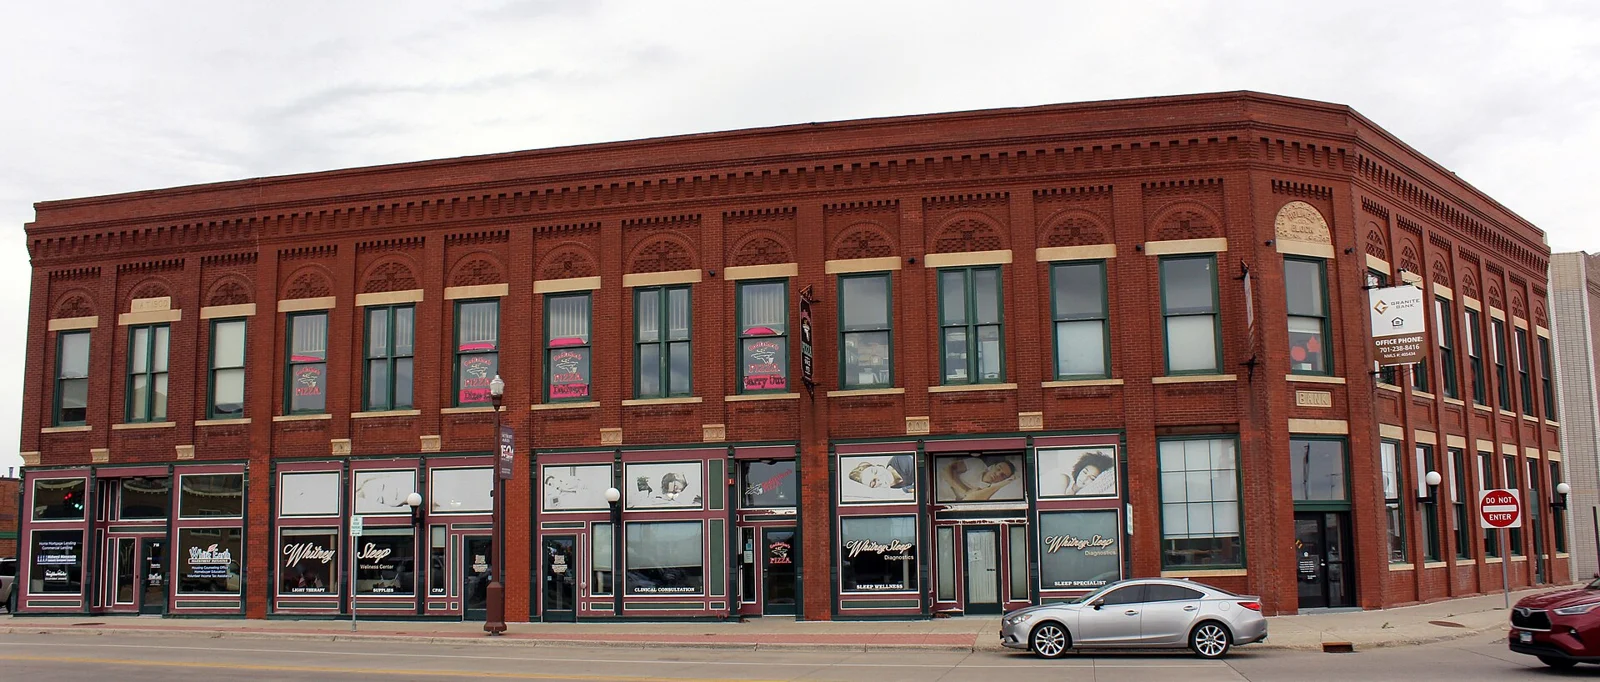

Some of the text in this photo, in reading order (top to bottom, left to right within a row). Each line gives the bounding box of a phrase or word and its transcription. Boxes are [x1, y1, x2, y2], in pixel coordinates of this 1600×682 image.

[1291, 223, 1314, 234] BLOCK
[1375, 336, 1423, 346] OFFICE PHONE:
[1380, 344, 1420, 353] 701-238-8416
[748, 363, 778, 373] PIZZA
[464, 378, 490, 387] PIZZA
[554, 373, 582, 382] PIZZA
[770, 376, 785, 384] Out
[296, 386, 321, 396] PIZZA
[1299, 392, 1330, 405] BANK
[1045, 534, 1114, 553] Whitney Sleep
[189, 546, 230, 559] White Earth
[357, 542, 391, 564] Sleep
[846, 540, 912, 558] Whitney Sleep
[283, 542, 336, 568] Whitney
